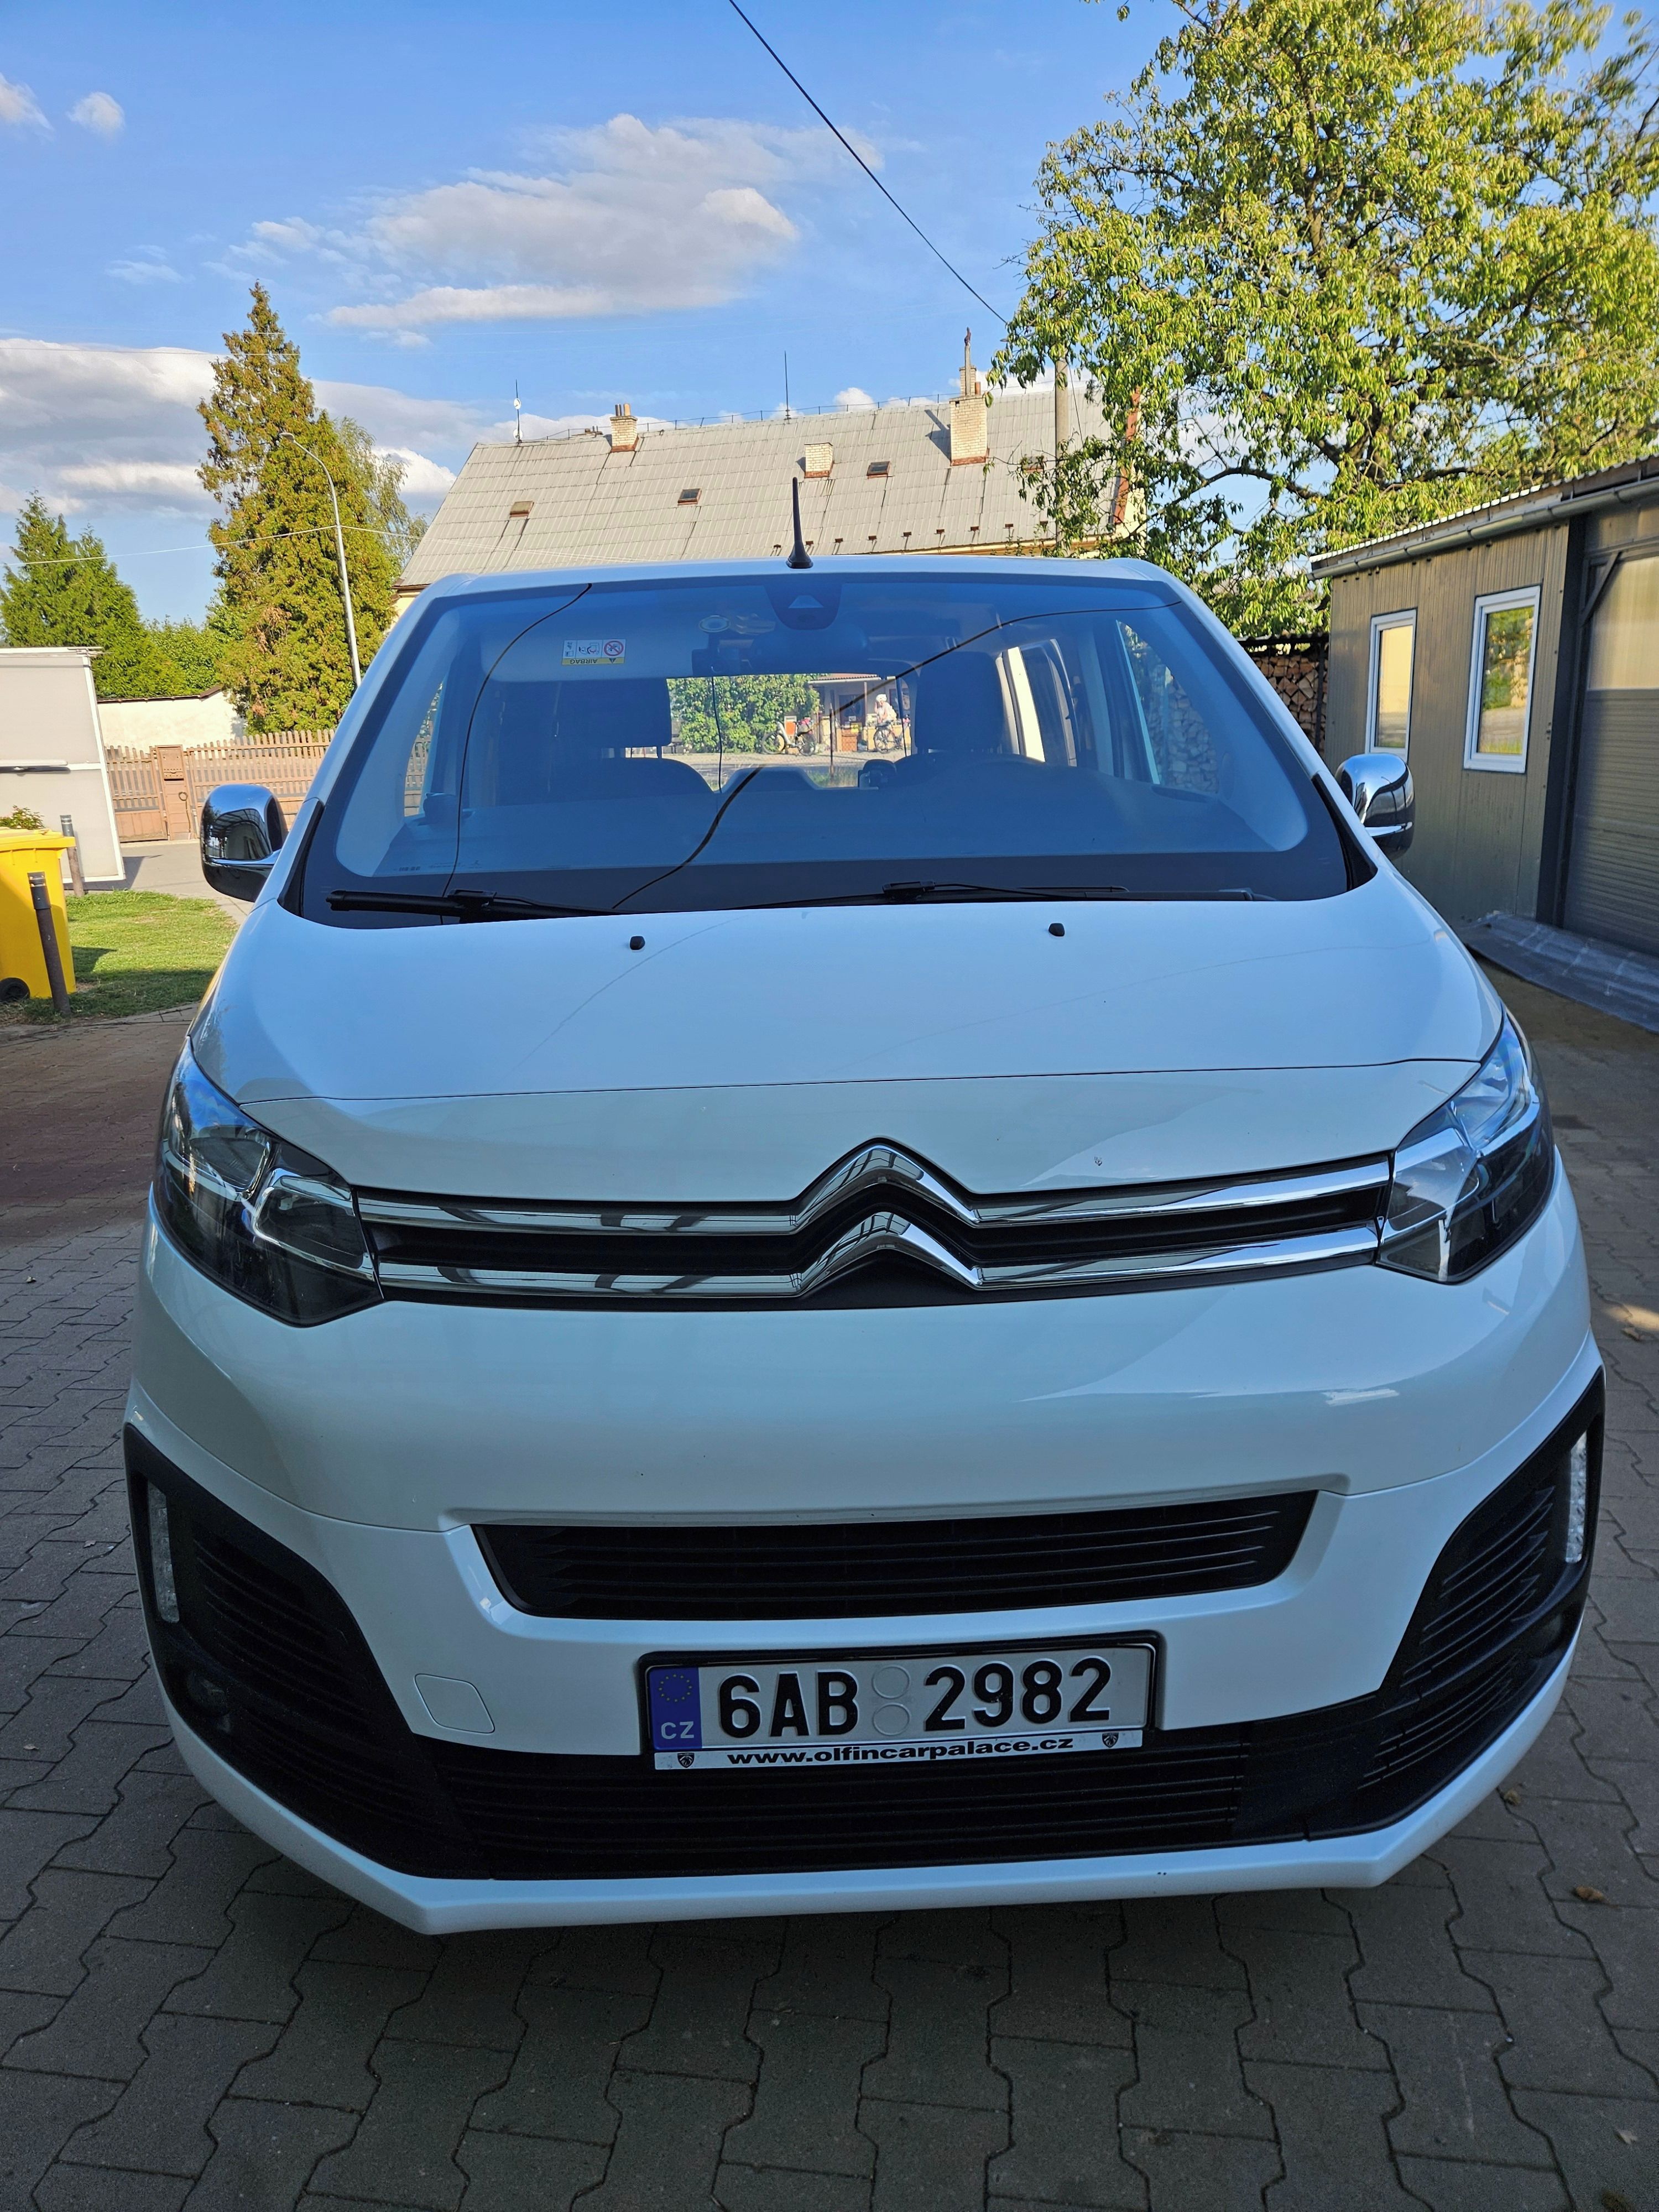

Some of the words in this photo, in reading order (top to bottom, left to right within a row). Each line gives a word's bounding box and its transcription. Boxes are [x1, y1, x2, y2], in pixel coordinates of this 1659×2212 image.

[718, 1671, 859, 1738] 6AB
[924, 1657, 1113, 1731] 2982
[661, 1721, 695, 1739] CZ
[727, 1738, 1074, 1764] www.olfincarpalace.cz
